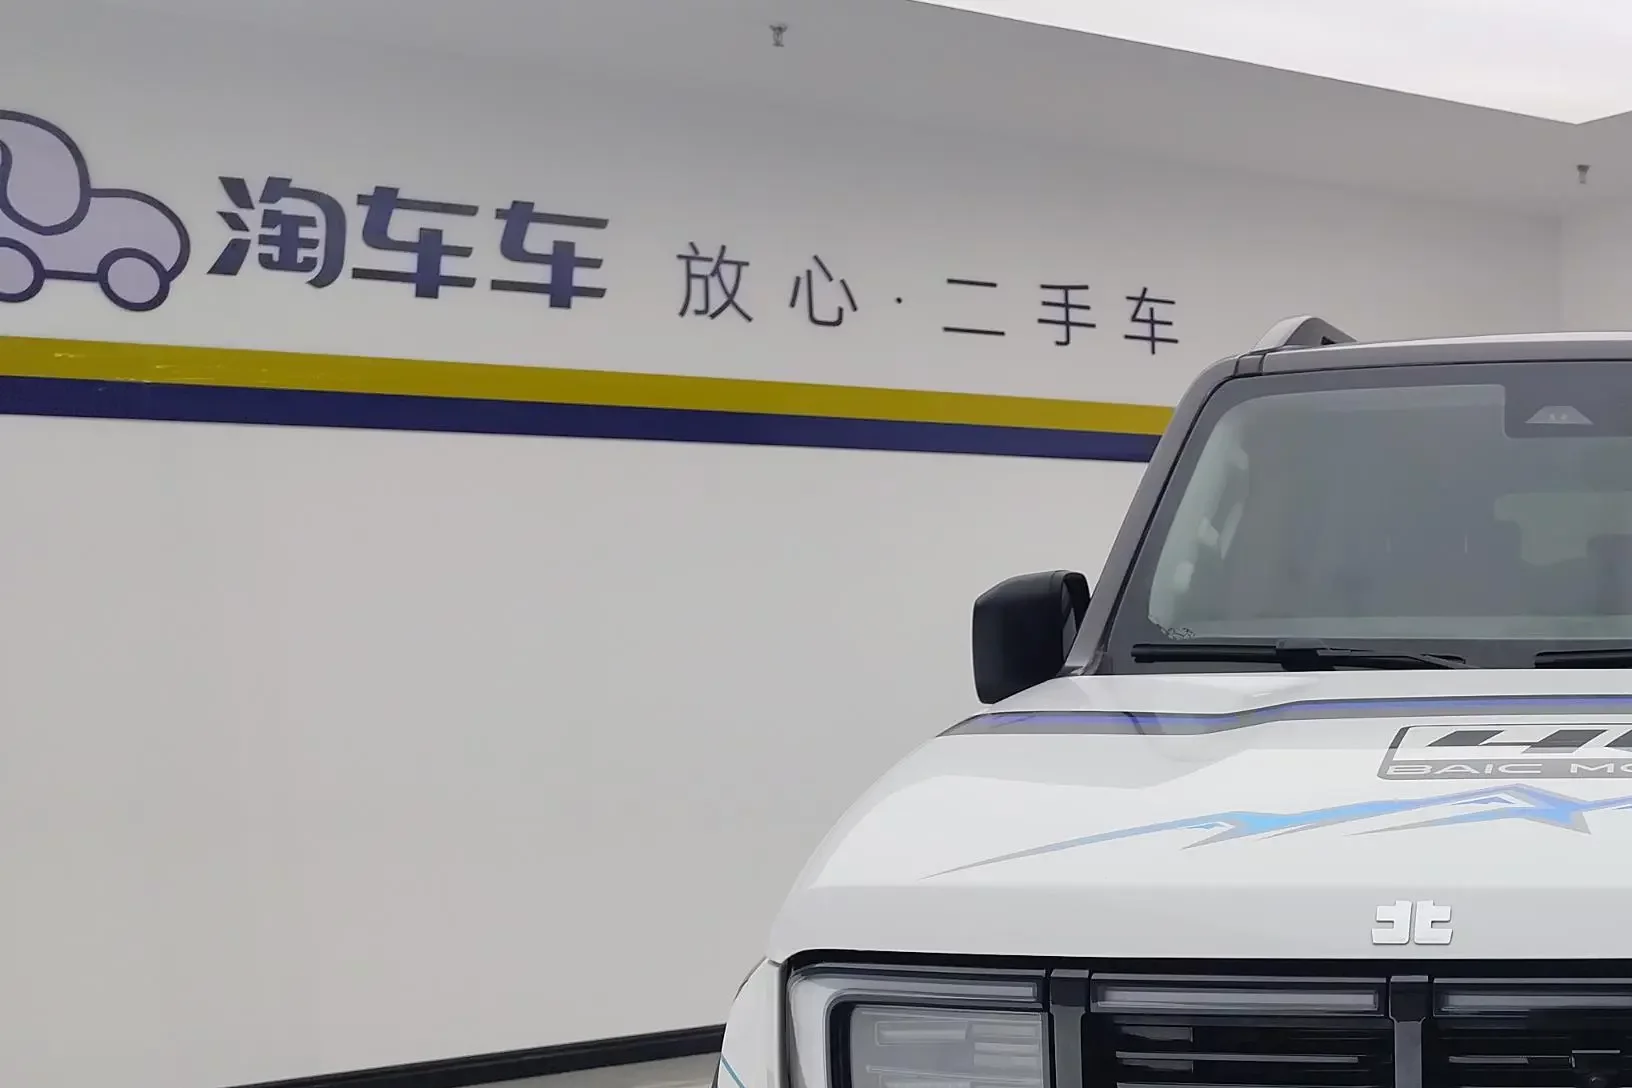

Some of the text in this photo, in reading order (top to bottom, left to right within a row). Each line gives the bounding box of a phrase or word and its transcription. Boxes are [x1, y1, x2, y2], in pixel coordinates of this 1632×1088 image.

[207, 176, 608, 309] 淘车车
[1386, 764, 1542, 775] BAIC
